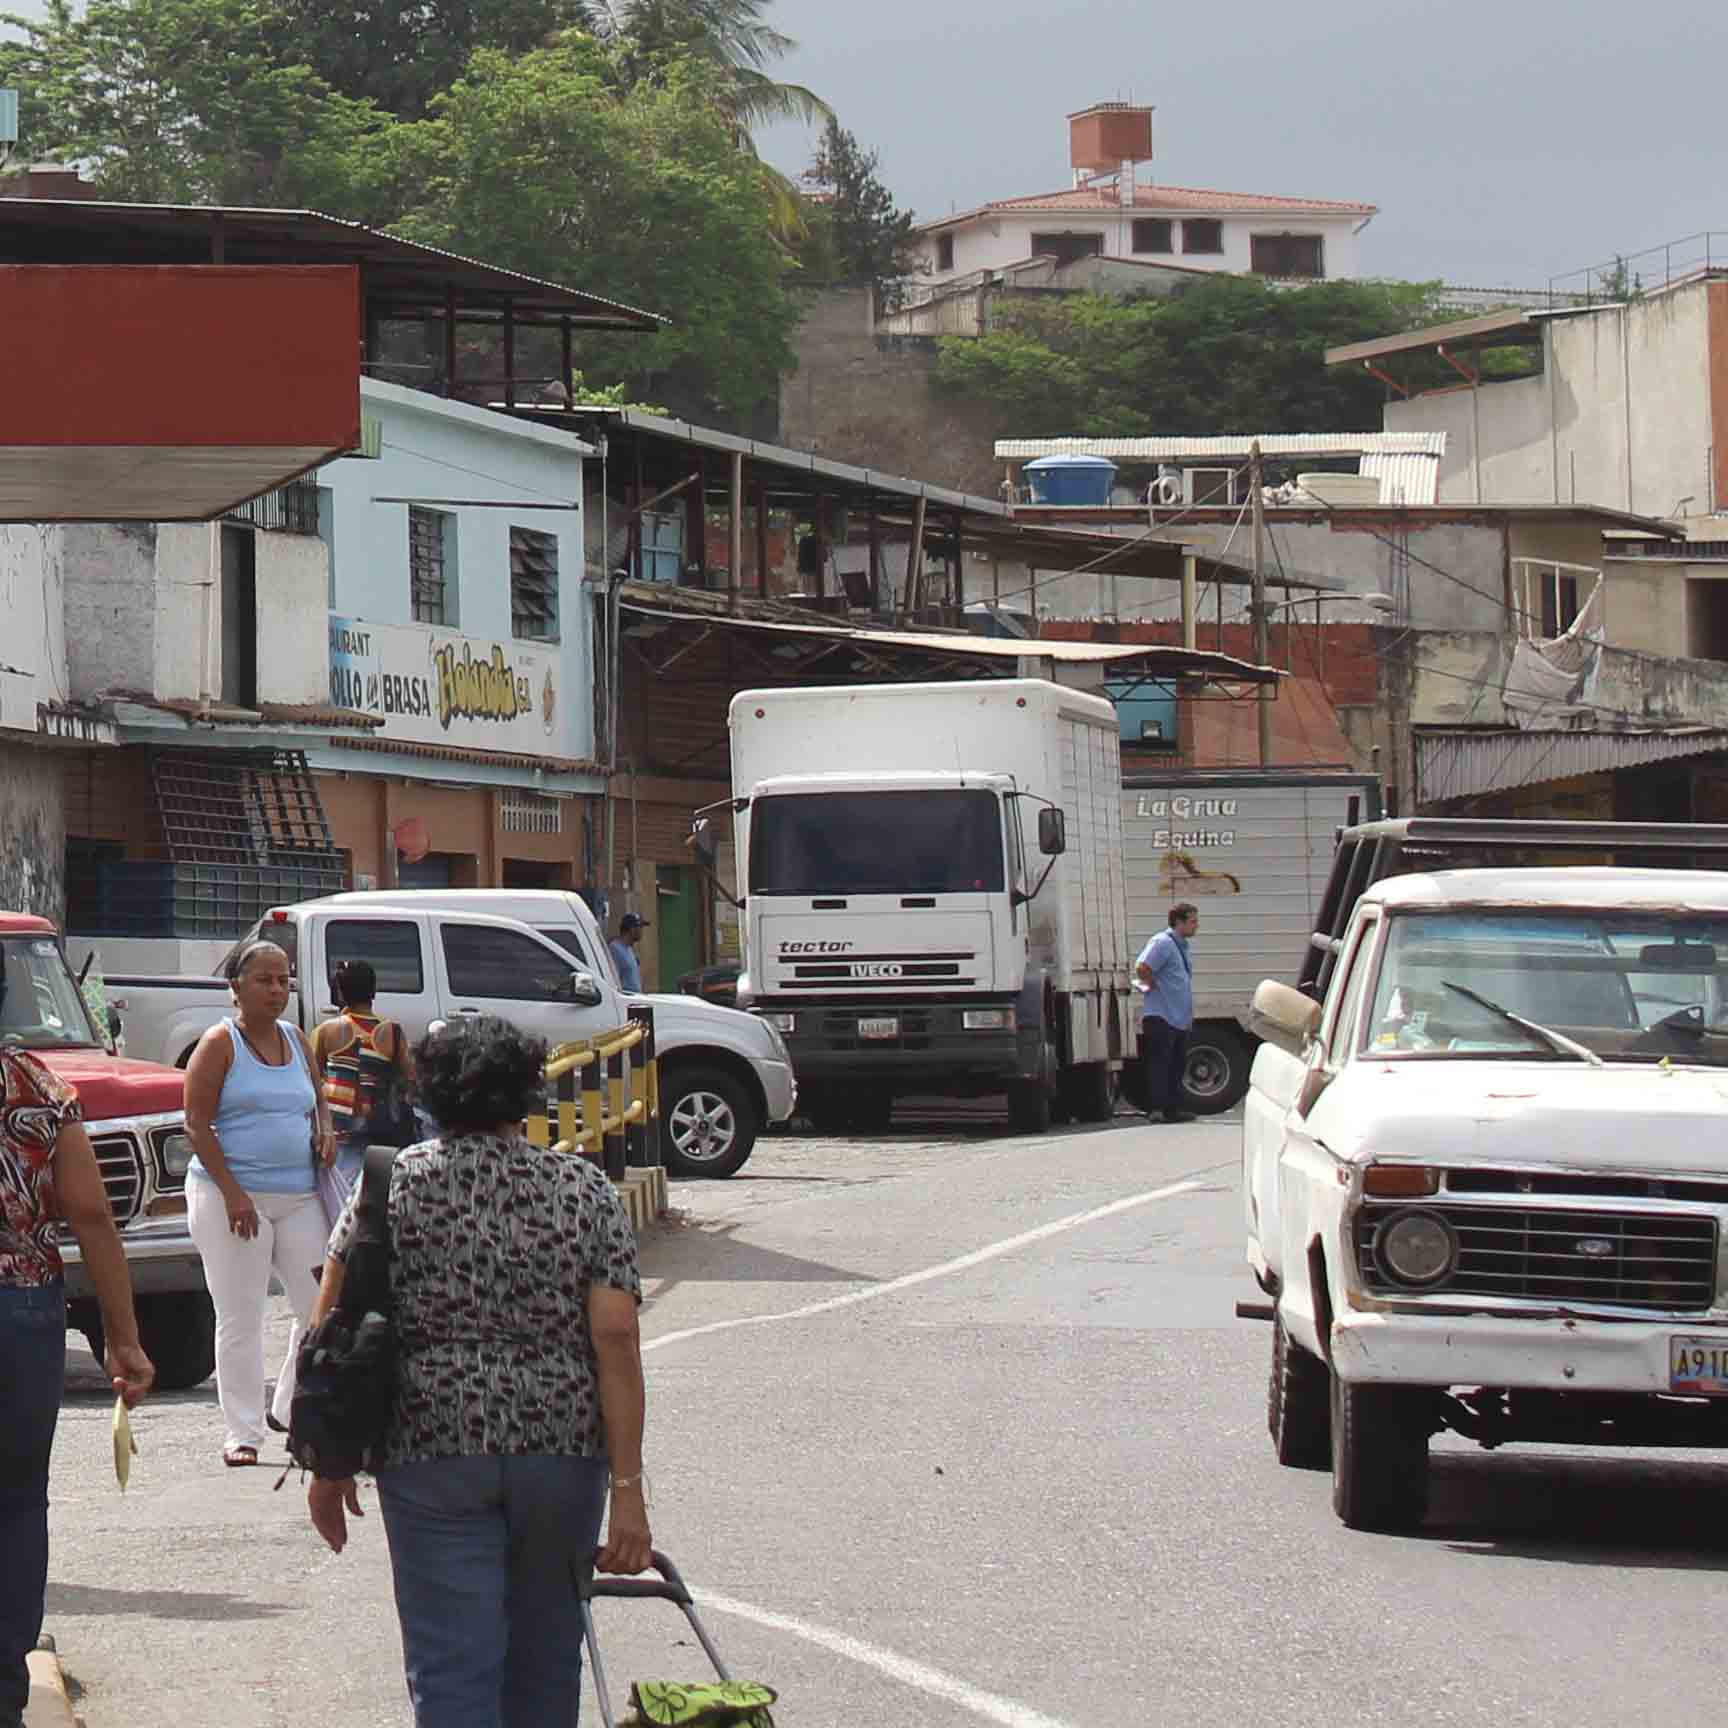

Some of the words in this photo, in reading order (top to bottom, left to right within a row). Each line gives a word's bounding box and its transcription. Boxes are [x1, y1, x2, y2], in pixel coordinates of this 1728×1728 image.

[382, 674, 432, 718] BRASA
[1136, 796, 1169, 817] La
[778, 940, 854, 953] tector
[849, 963, 903, 978] IVECO
